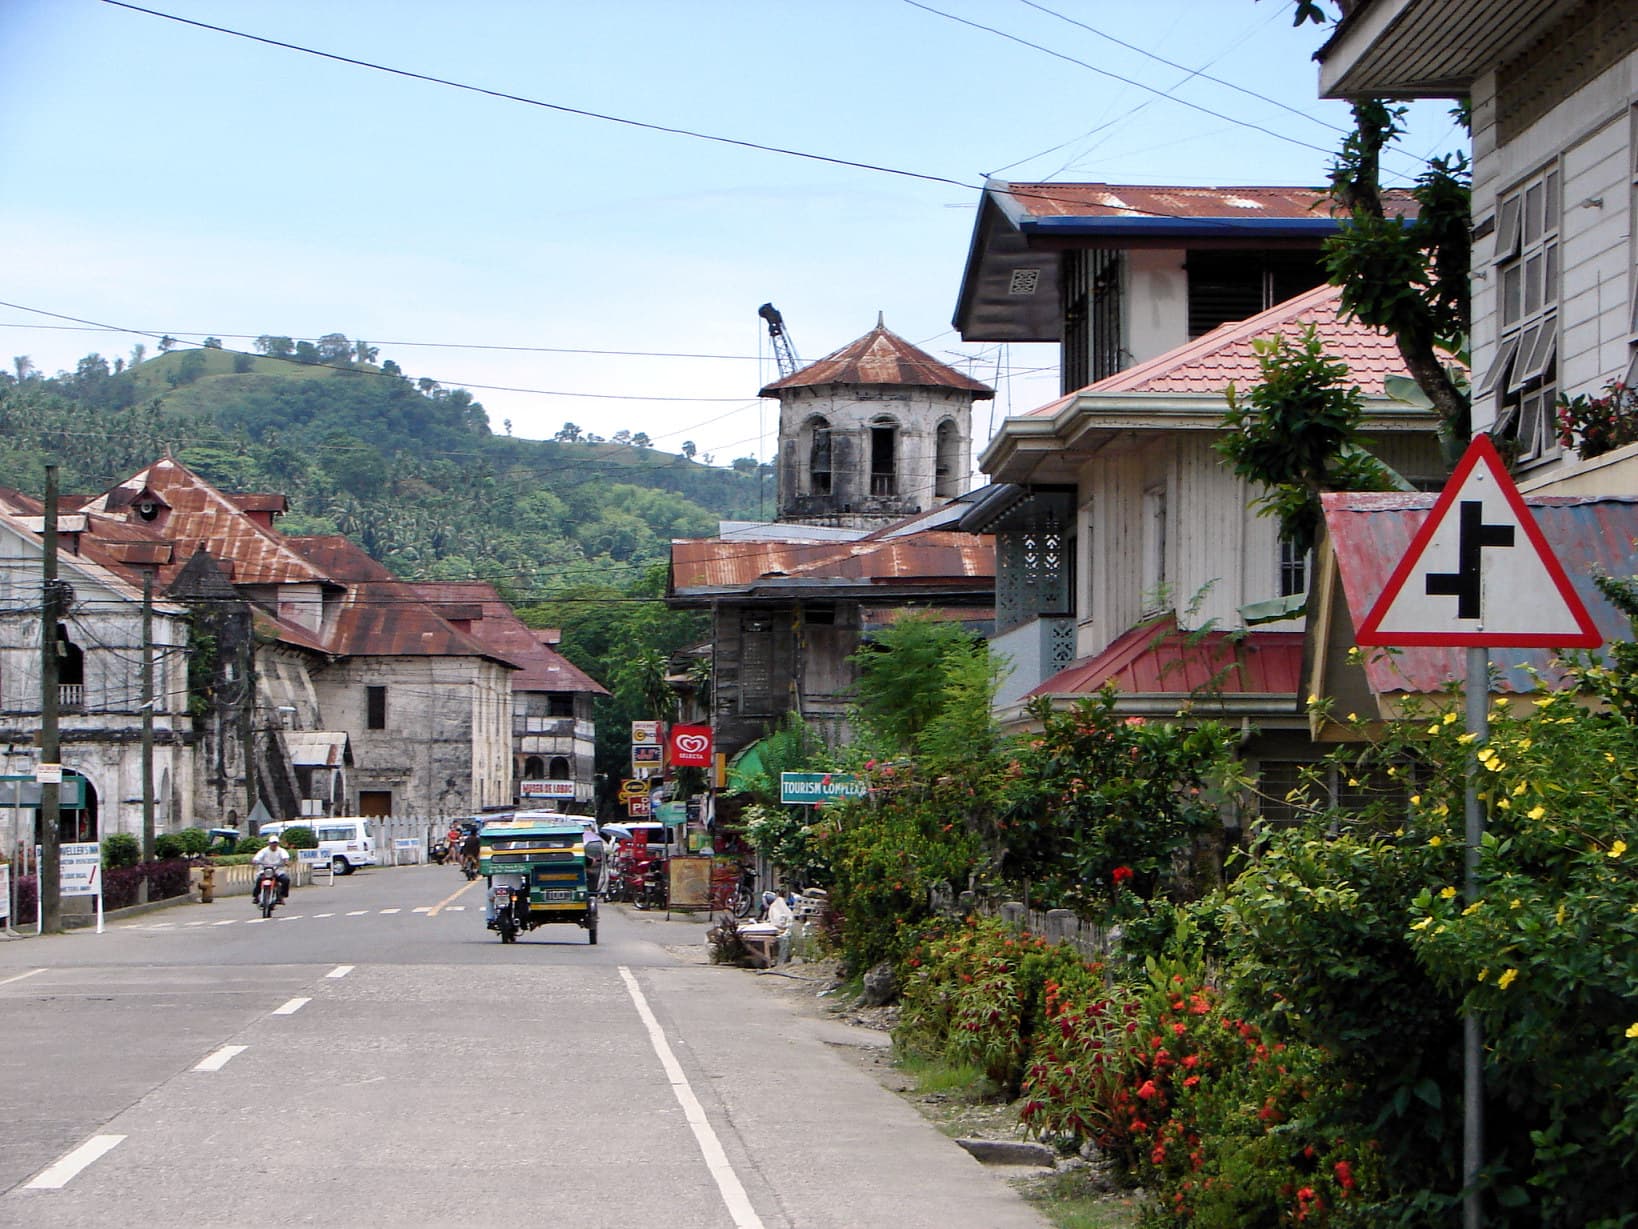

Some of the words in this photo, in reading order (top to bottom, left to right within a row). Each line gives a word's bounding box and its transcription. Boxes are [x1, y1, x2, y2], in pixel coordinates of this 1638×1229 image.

[679, 752, 704, 760] SELECTA
[783, 781, 821, 794] TOURISM
[299, 850, 318, 859] THANK
[320, 849, 332, 858] YOU
